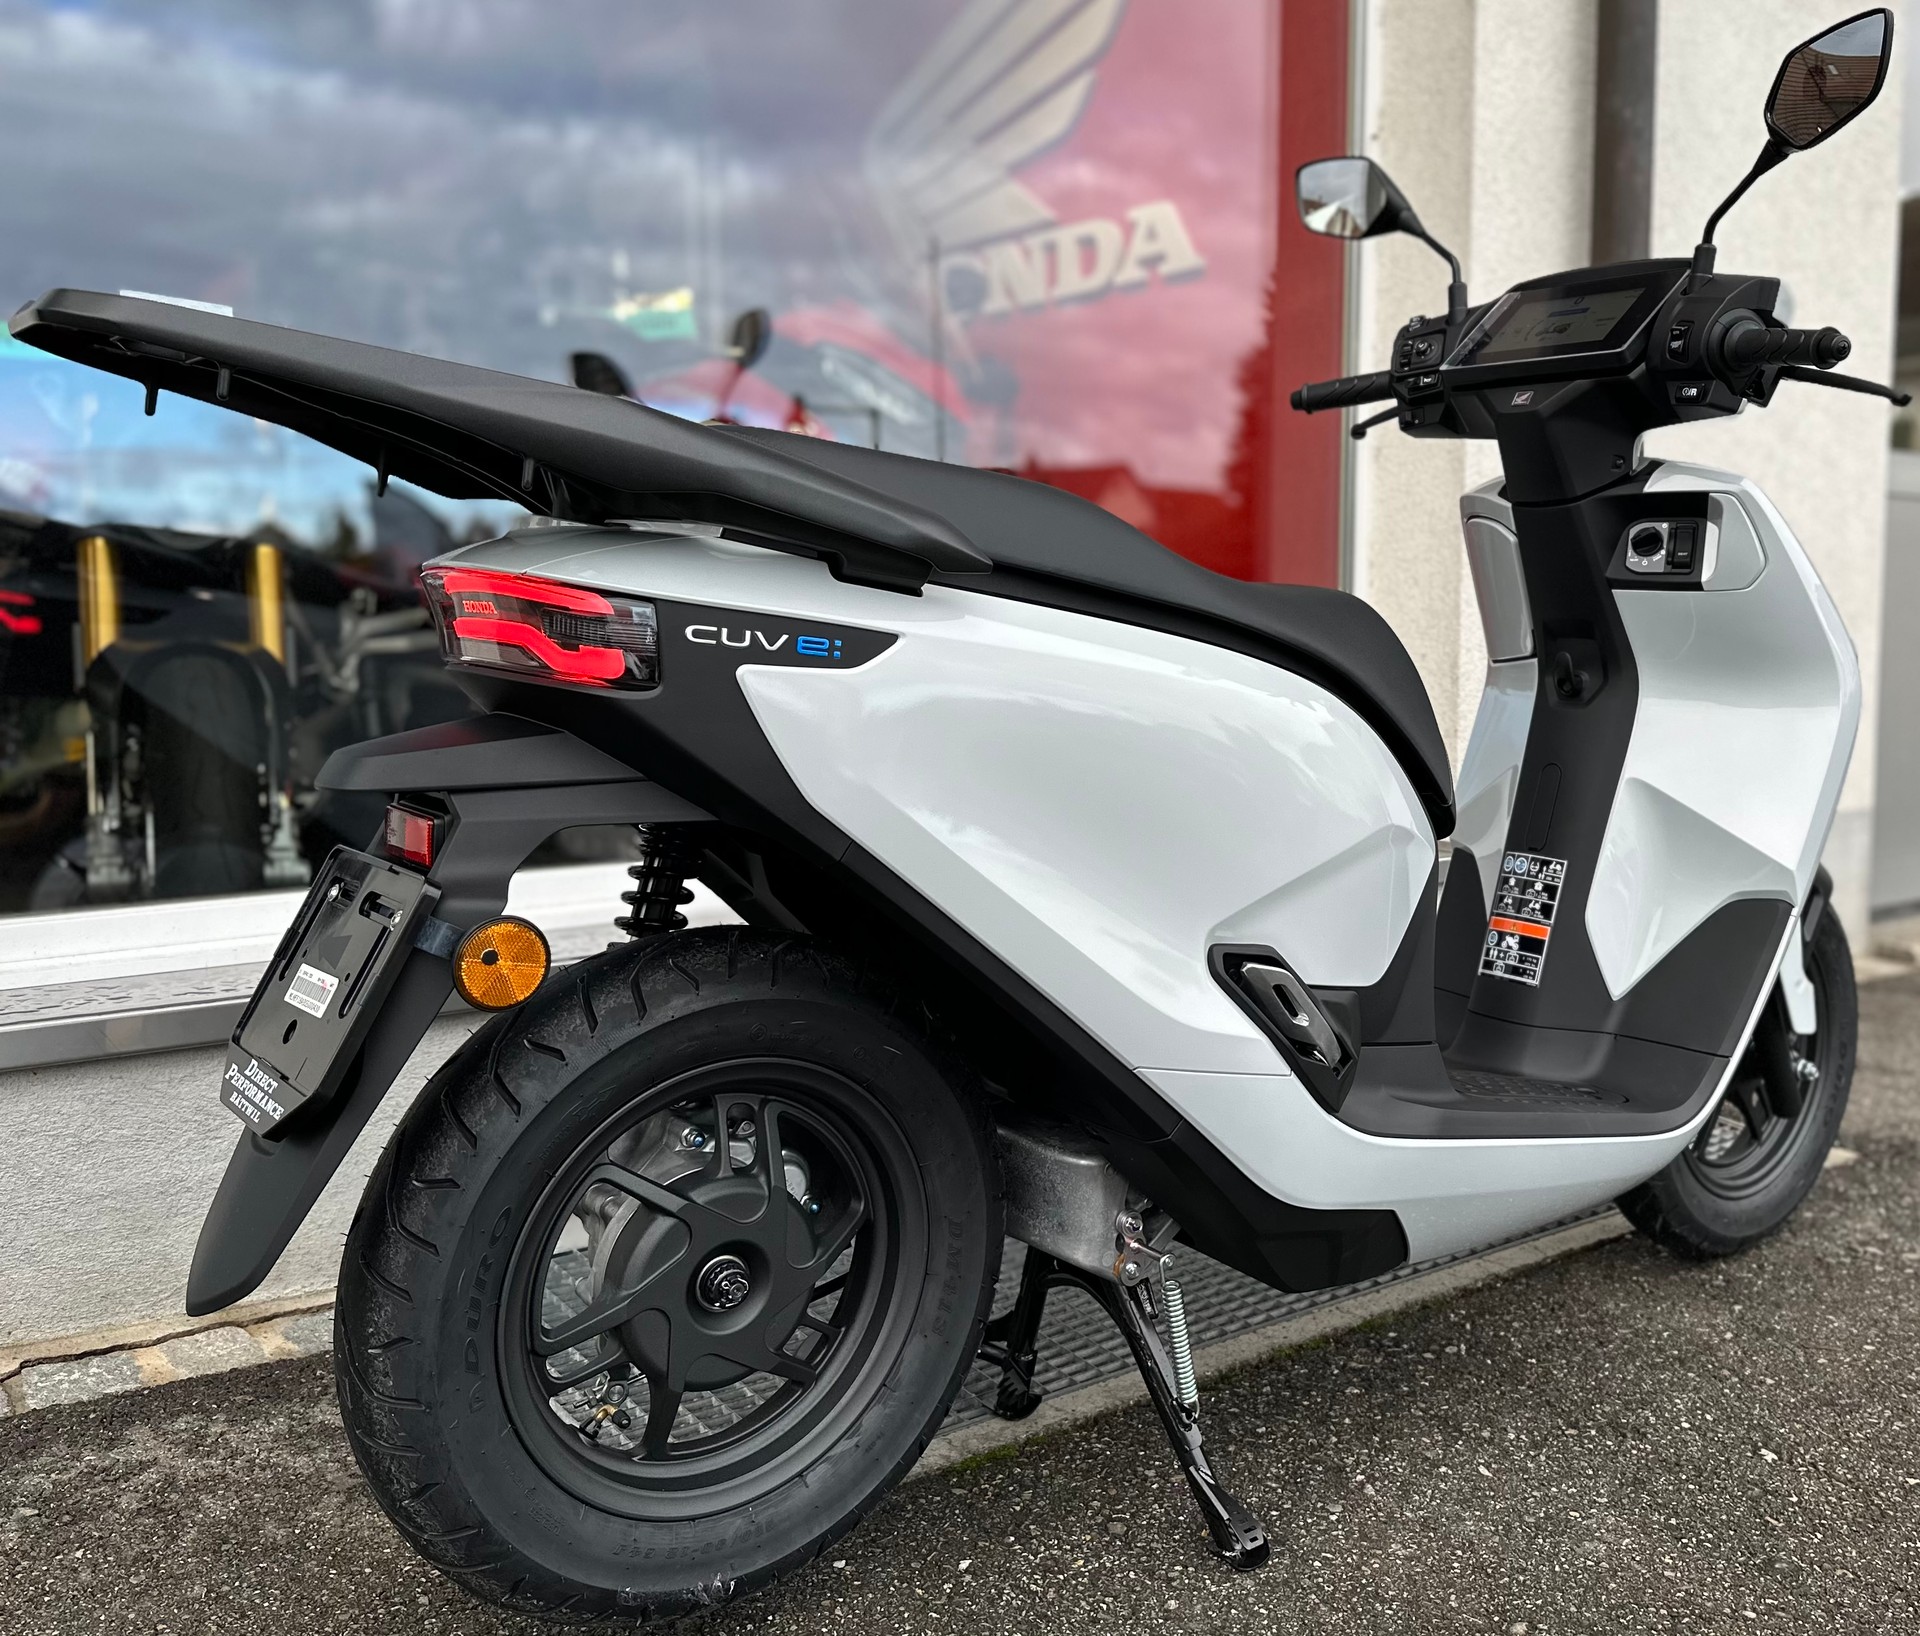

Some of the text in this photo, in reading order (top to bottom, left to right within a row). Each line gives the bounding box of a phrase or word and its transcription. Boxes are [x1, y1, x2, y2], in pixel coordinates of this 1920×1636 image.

[462, 600, 498, 615] HONDA
[684, 624, 790, 652] CUV
[796, 635, 843, 660] e:
[224, 1062, 285, 1121] PERFORMANCE
[243, 1058, 279, 1095] DIRECT
